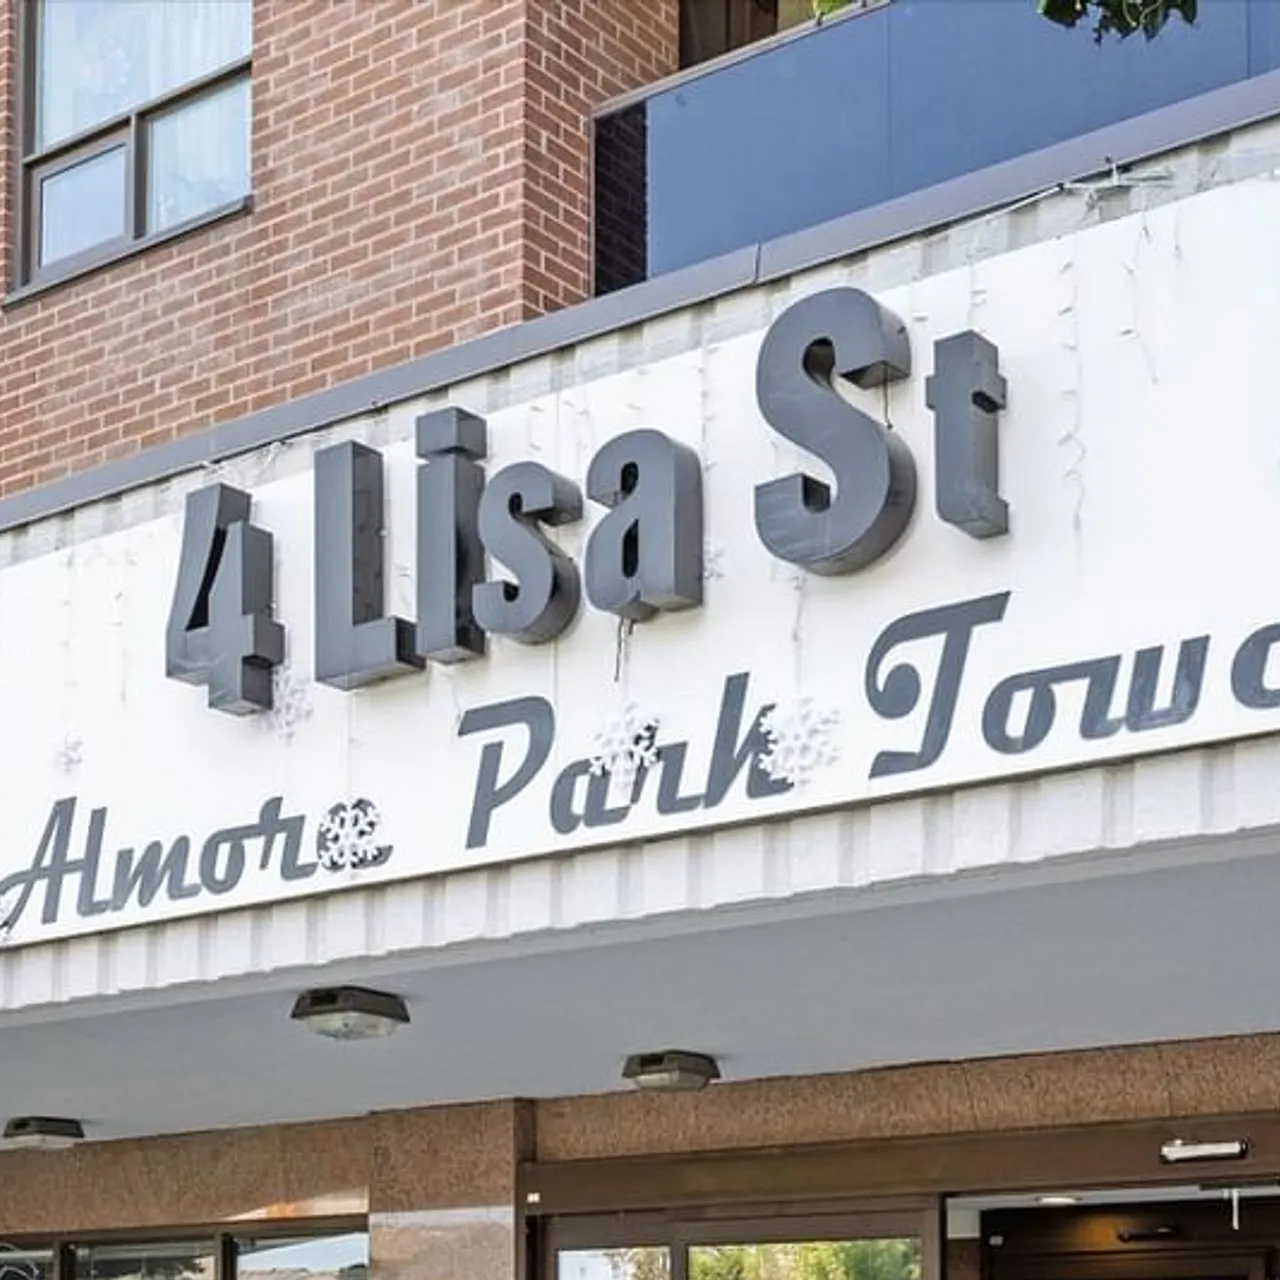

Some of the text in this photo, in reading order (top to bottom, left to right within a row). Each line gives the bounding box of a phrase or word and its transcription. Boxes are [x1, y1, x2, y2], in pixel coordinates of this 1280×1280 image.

[166, 287, 1009, 716] 4 Lisa St
[458, 672, 795, 850] Park
